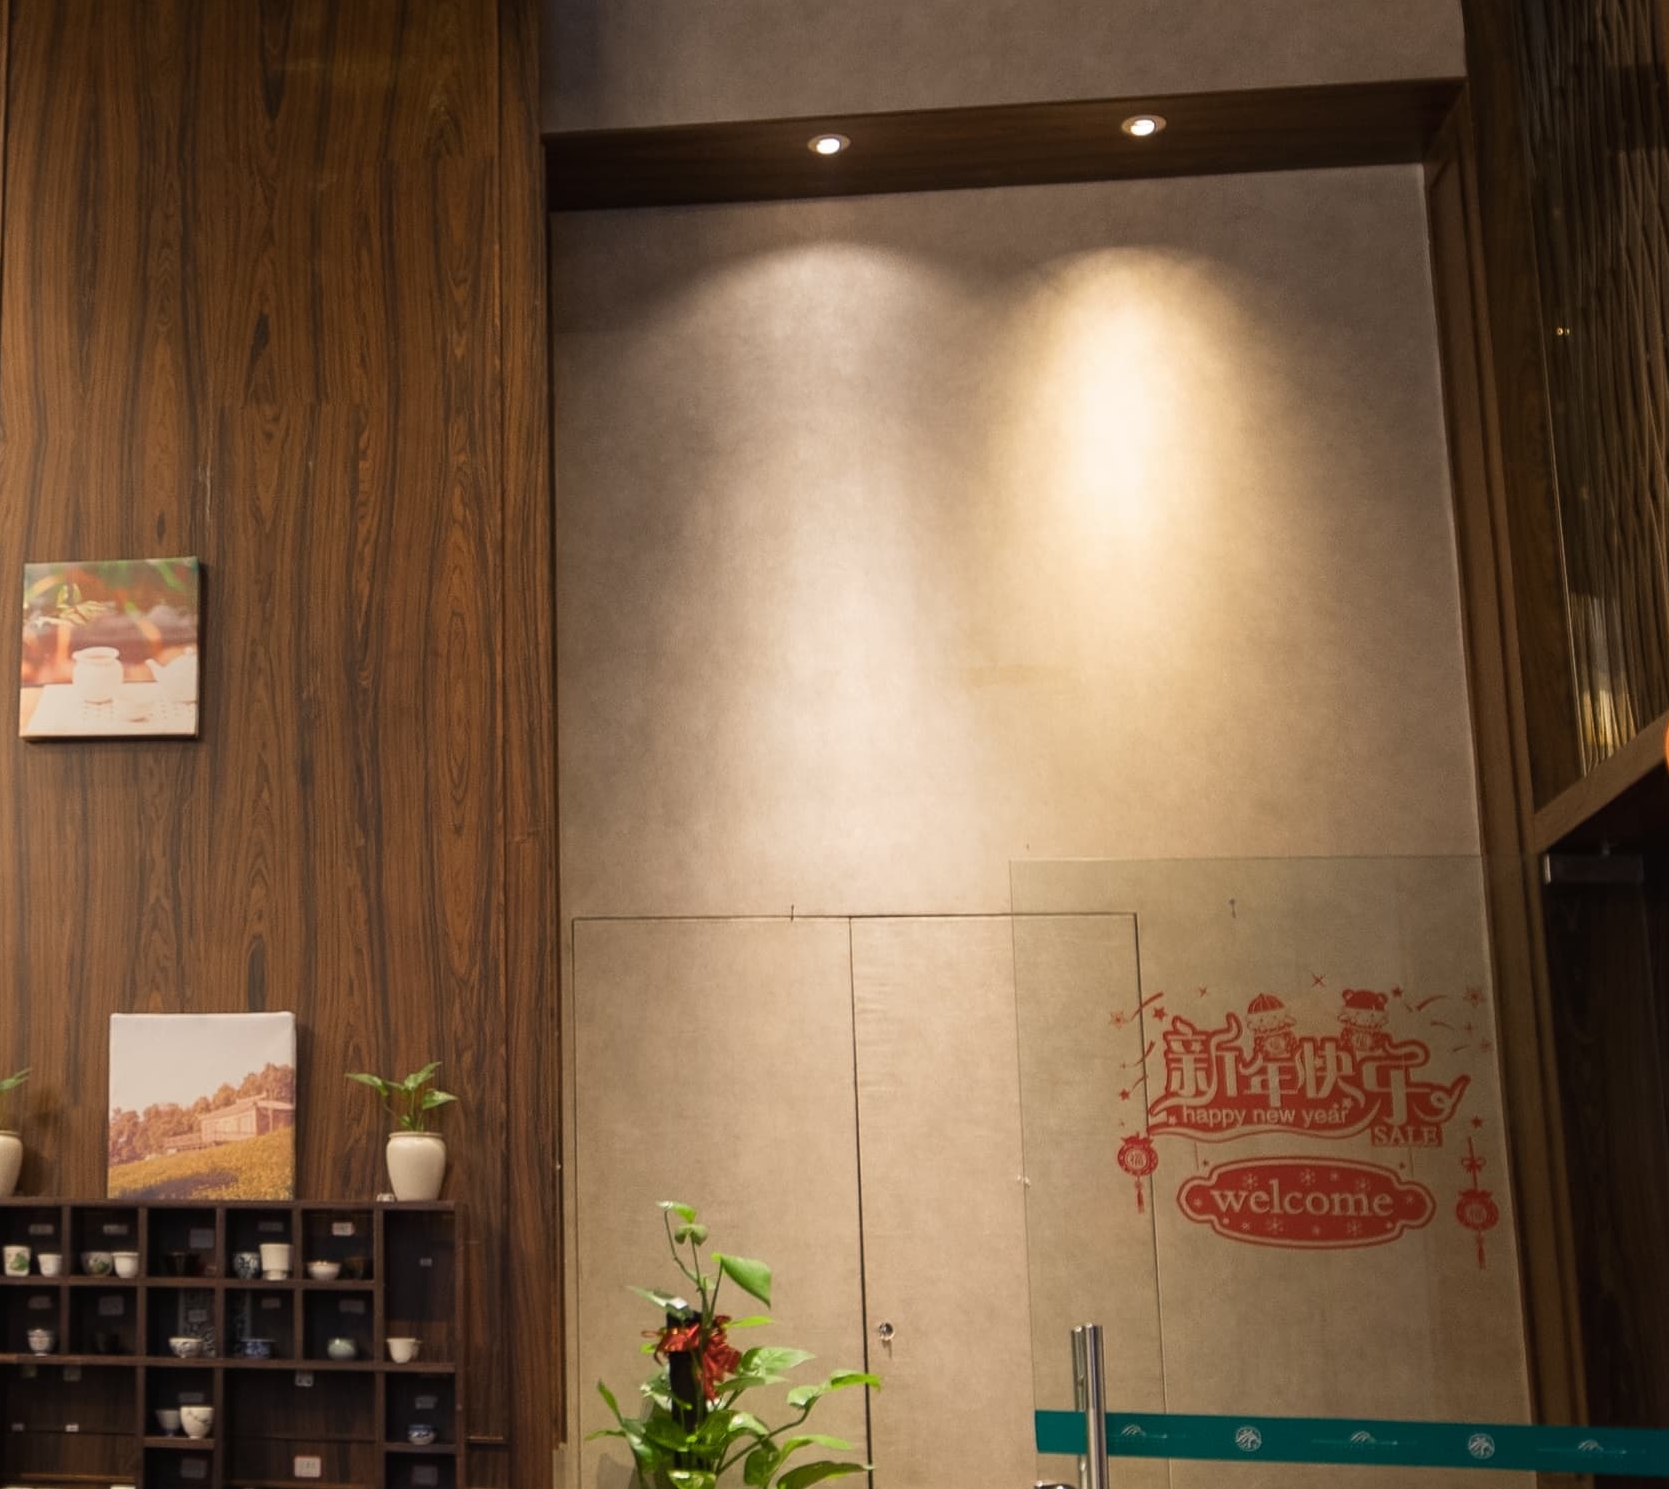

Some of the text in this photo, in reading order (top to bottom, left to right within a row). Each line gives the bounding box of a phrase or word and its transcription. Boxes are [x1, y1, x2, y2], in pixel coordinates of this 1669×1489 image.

[1150, 1013, 1469, 1127] 新年快乐
[1184, 1105, 1349, 1127] happy new year
[1372, 1125, 1440, 1146] SALE
[1211, 1179, 1395, 1217] welcome
